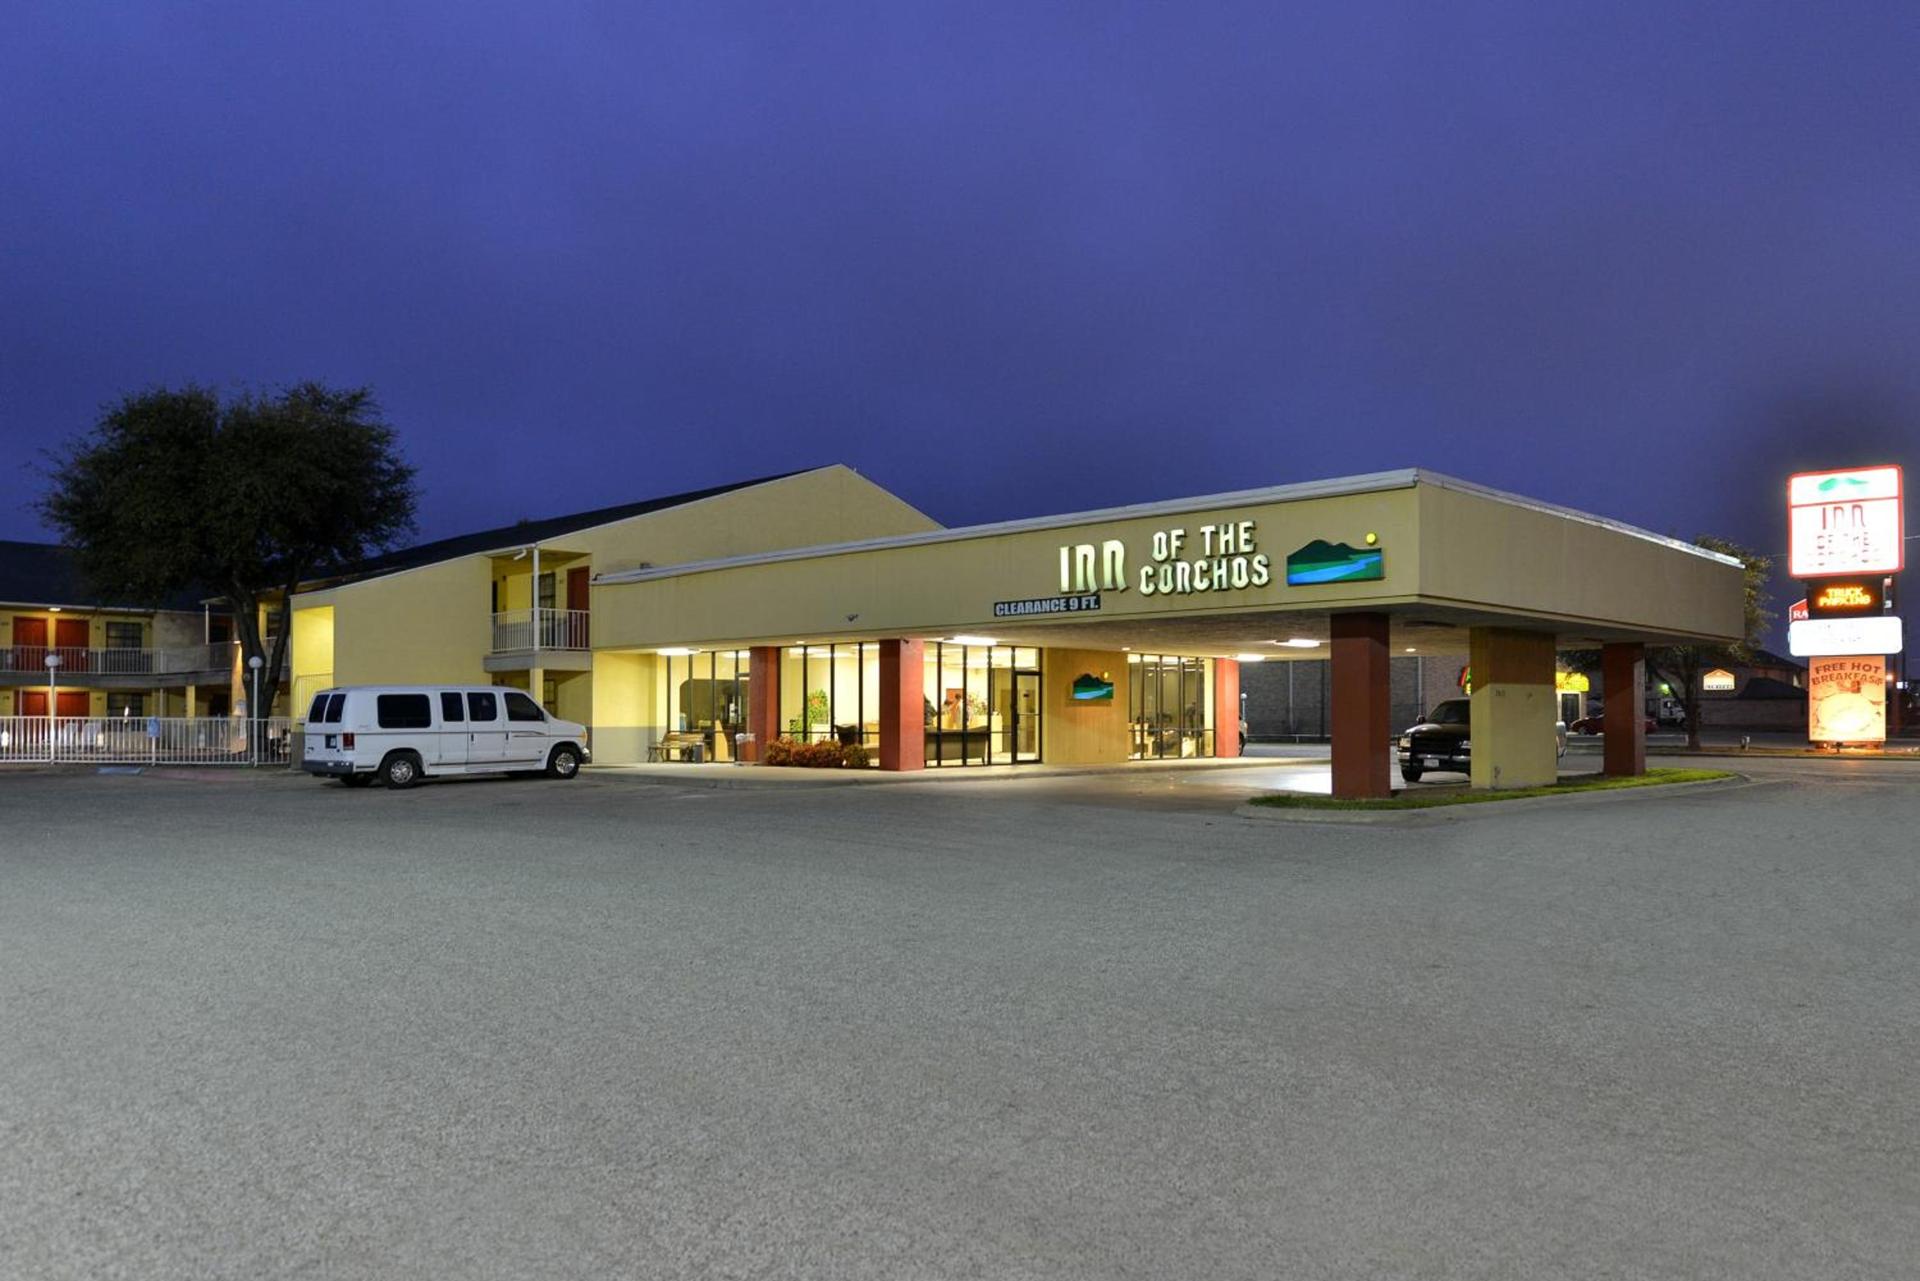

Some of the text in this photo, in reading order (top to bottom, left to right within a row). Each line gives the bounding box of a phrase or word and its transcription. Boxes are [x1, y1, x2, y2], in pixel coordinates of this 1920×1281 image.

[1152, 520, 1257, 562] OF THE
[1059, 540, 1129, 593] INN
[1139, 554, 1271, 596] CONCHOS
[995, 596, 1099, 616] CLEARANCE 9 FT.
[1815, 661, 1881, 674] FREE HOT
